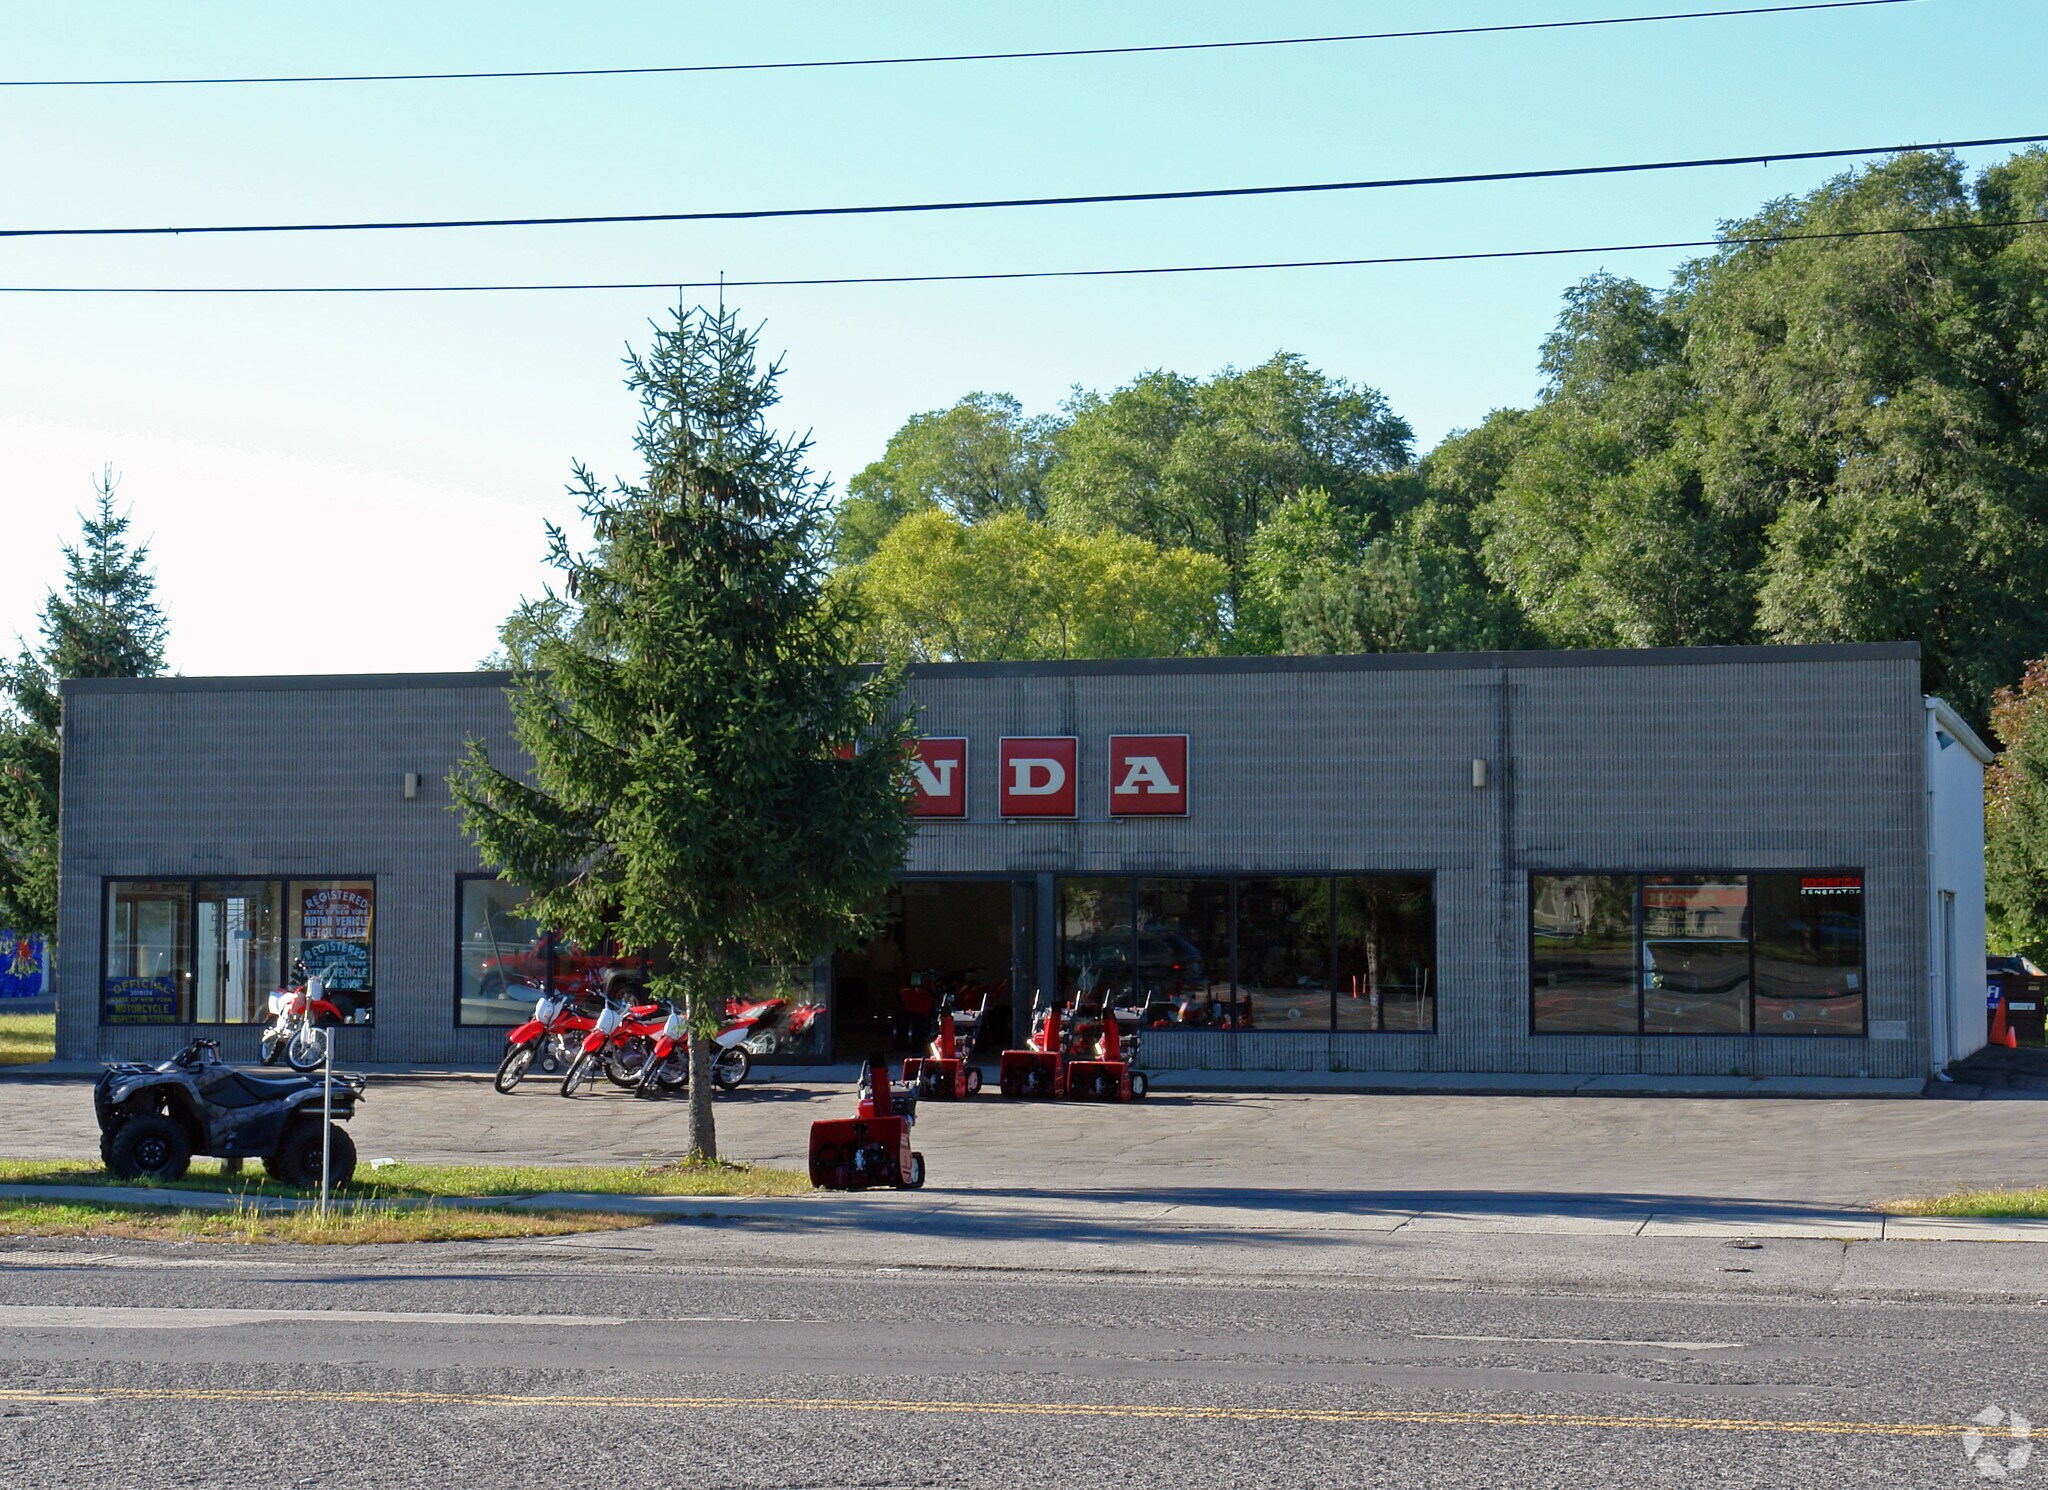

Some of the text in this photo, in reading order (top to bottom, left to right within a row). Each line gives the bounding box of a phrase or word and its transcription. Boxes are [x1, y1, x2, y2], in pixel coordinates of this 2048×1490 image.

[903, 757, 1180, 797] NDA
[305, 890, 369, 909] REGISTERED
[1648, 908, 1688, 919] Power
[304, 916, 369, 927] MOTOR VEHICLE
[1648, 924, 1718, 936] Equipment
[304, 941, 367, 960] REGISTERED
[333, 967, 368, 978] VEHICLE
[113, 979, 170, 994] OFFICIAL
[340, 980, 363, 989] SHOP
[115, 1004, 169, 1014] MOTORCYCLE
[149, 1015, 176, 1023] STATION
